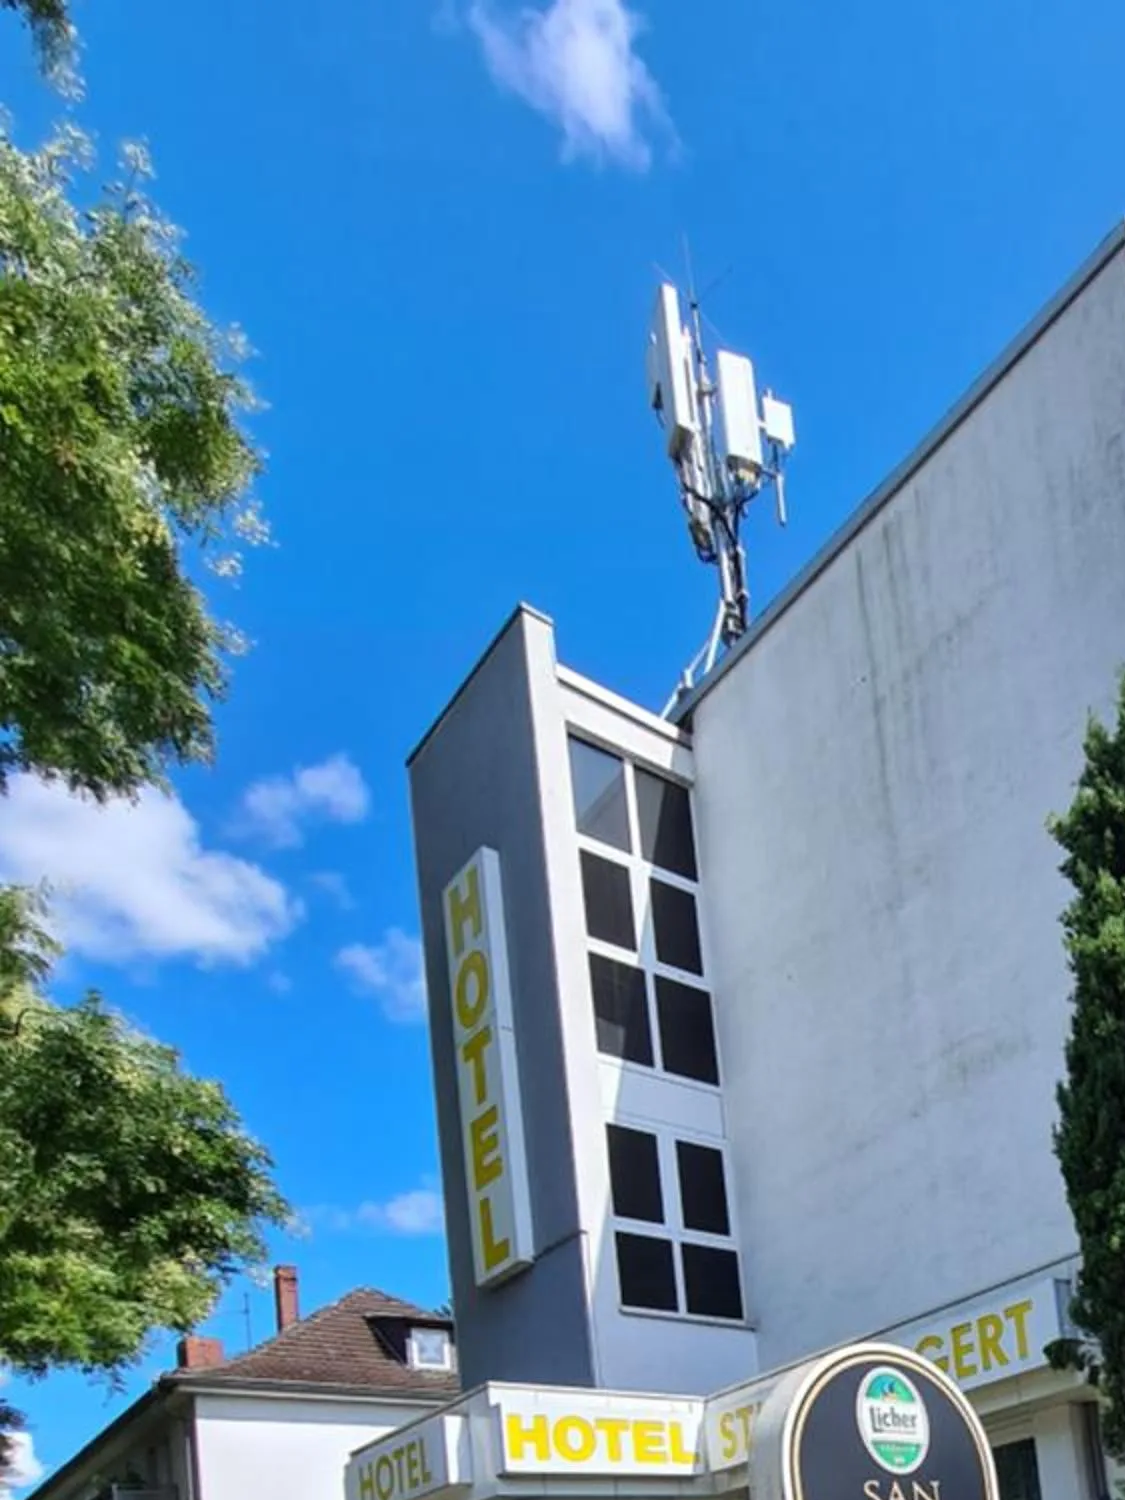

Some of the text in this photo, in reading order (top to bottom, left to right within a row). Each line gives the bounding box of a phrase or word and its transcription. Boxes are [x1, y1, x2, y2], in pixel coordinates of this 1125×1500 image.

[447, 867, 510, 1273] HOTEL
[506, 1413, 700, 1465] HOTEL
[869, 1406, 917, 1433] Licher
